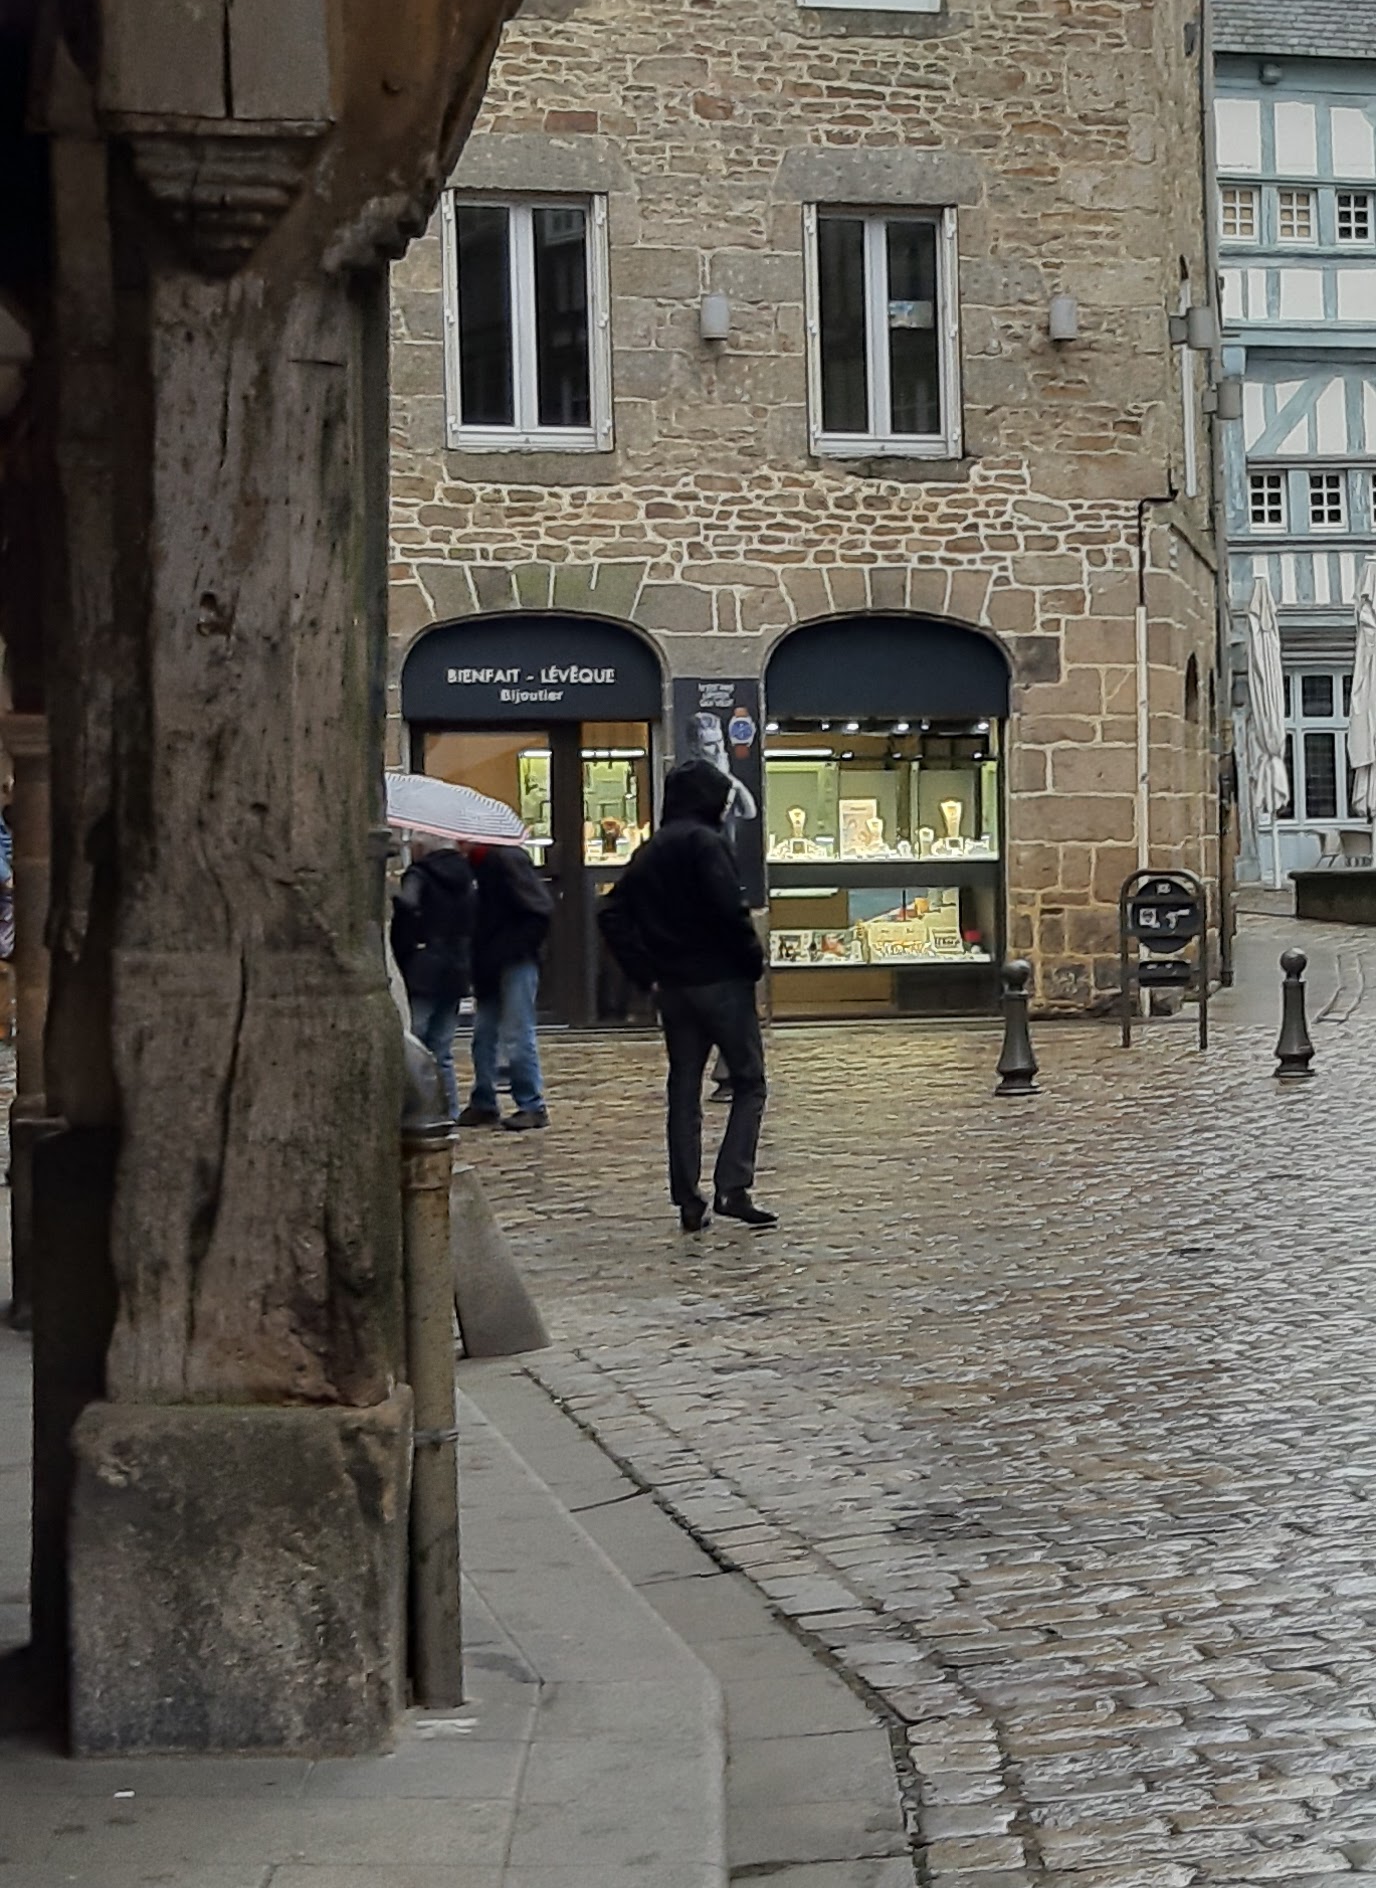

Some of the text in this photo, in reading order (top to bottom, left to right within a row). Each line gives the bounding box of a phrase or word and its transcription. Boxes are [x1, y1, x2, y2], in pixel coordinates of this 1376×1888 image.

[446, 668, 521, 683] BIENFAIT
[540, 665, 616, 683] LÉVÊQUE
[501, 689, 564, 704] Bijoutier
